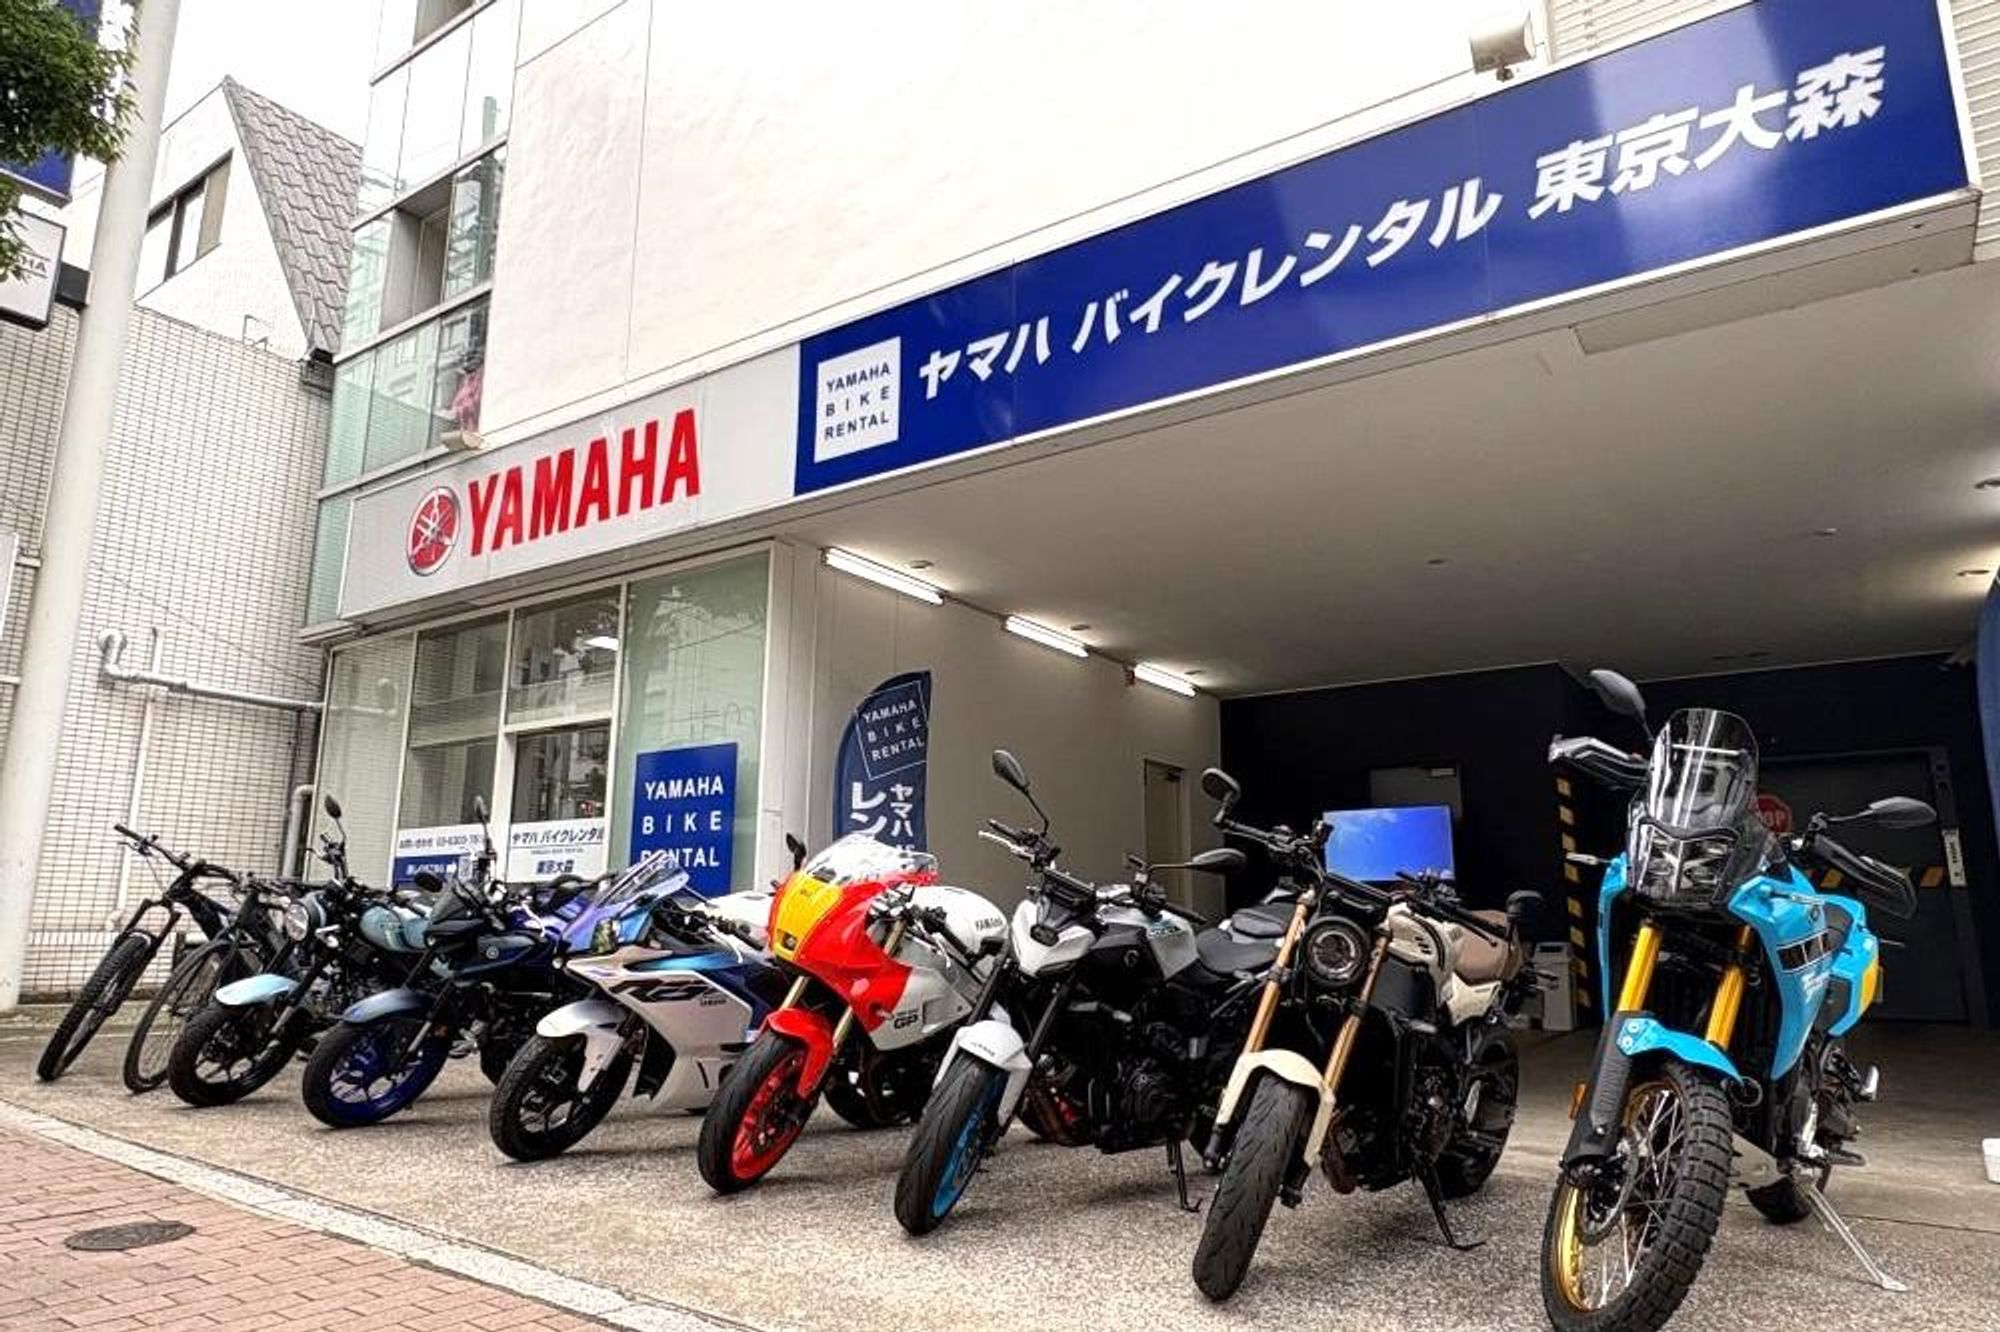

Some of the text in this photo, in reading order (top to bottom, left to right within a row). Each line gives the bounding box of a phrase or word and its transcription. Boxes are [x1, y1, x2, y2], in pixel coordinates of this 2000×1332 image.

[920, 46, 1885, 399] ヤマハ バイクレンタル 東京大森
[826, 362, 891, 393] YAMAHA
[826, 386, 890, 417] BIKE
[825, 411, 889, 440] RENTAL
[468, 408, 701, 557] YAMAHA
[862, 699, 917, 724] YAMAHA
[867, 719, 923, 743] BIKE
[871, 737, 925, 761] RENTAL
[644, 775, 724, 801] YAMAHA
[512, 826, 605, 845] ヤマハ バイクレンタル
[641, 810, 722, 836] BIKE
[640, 846, 720, 869] RNTAL
